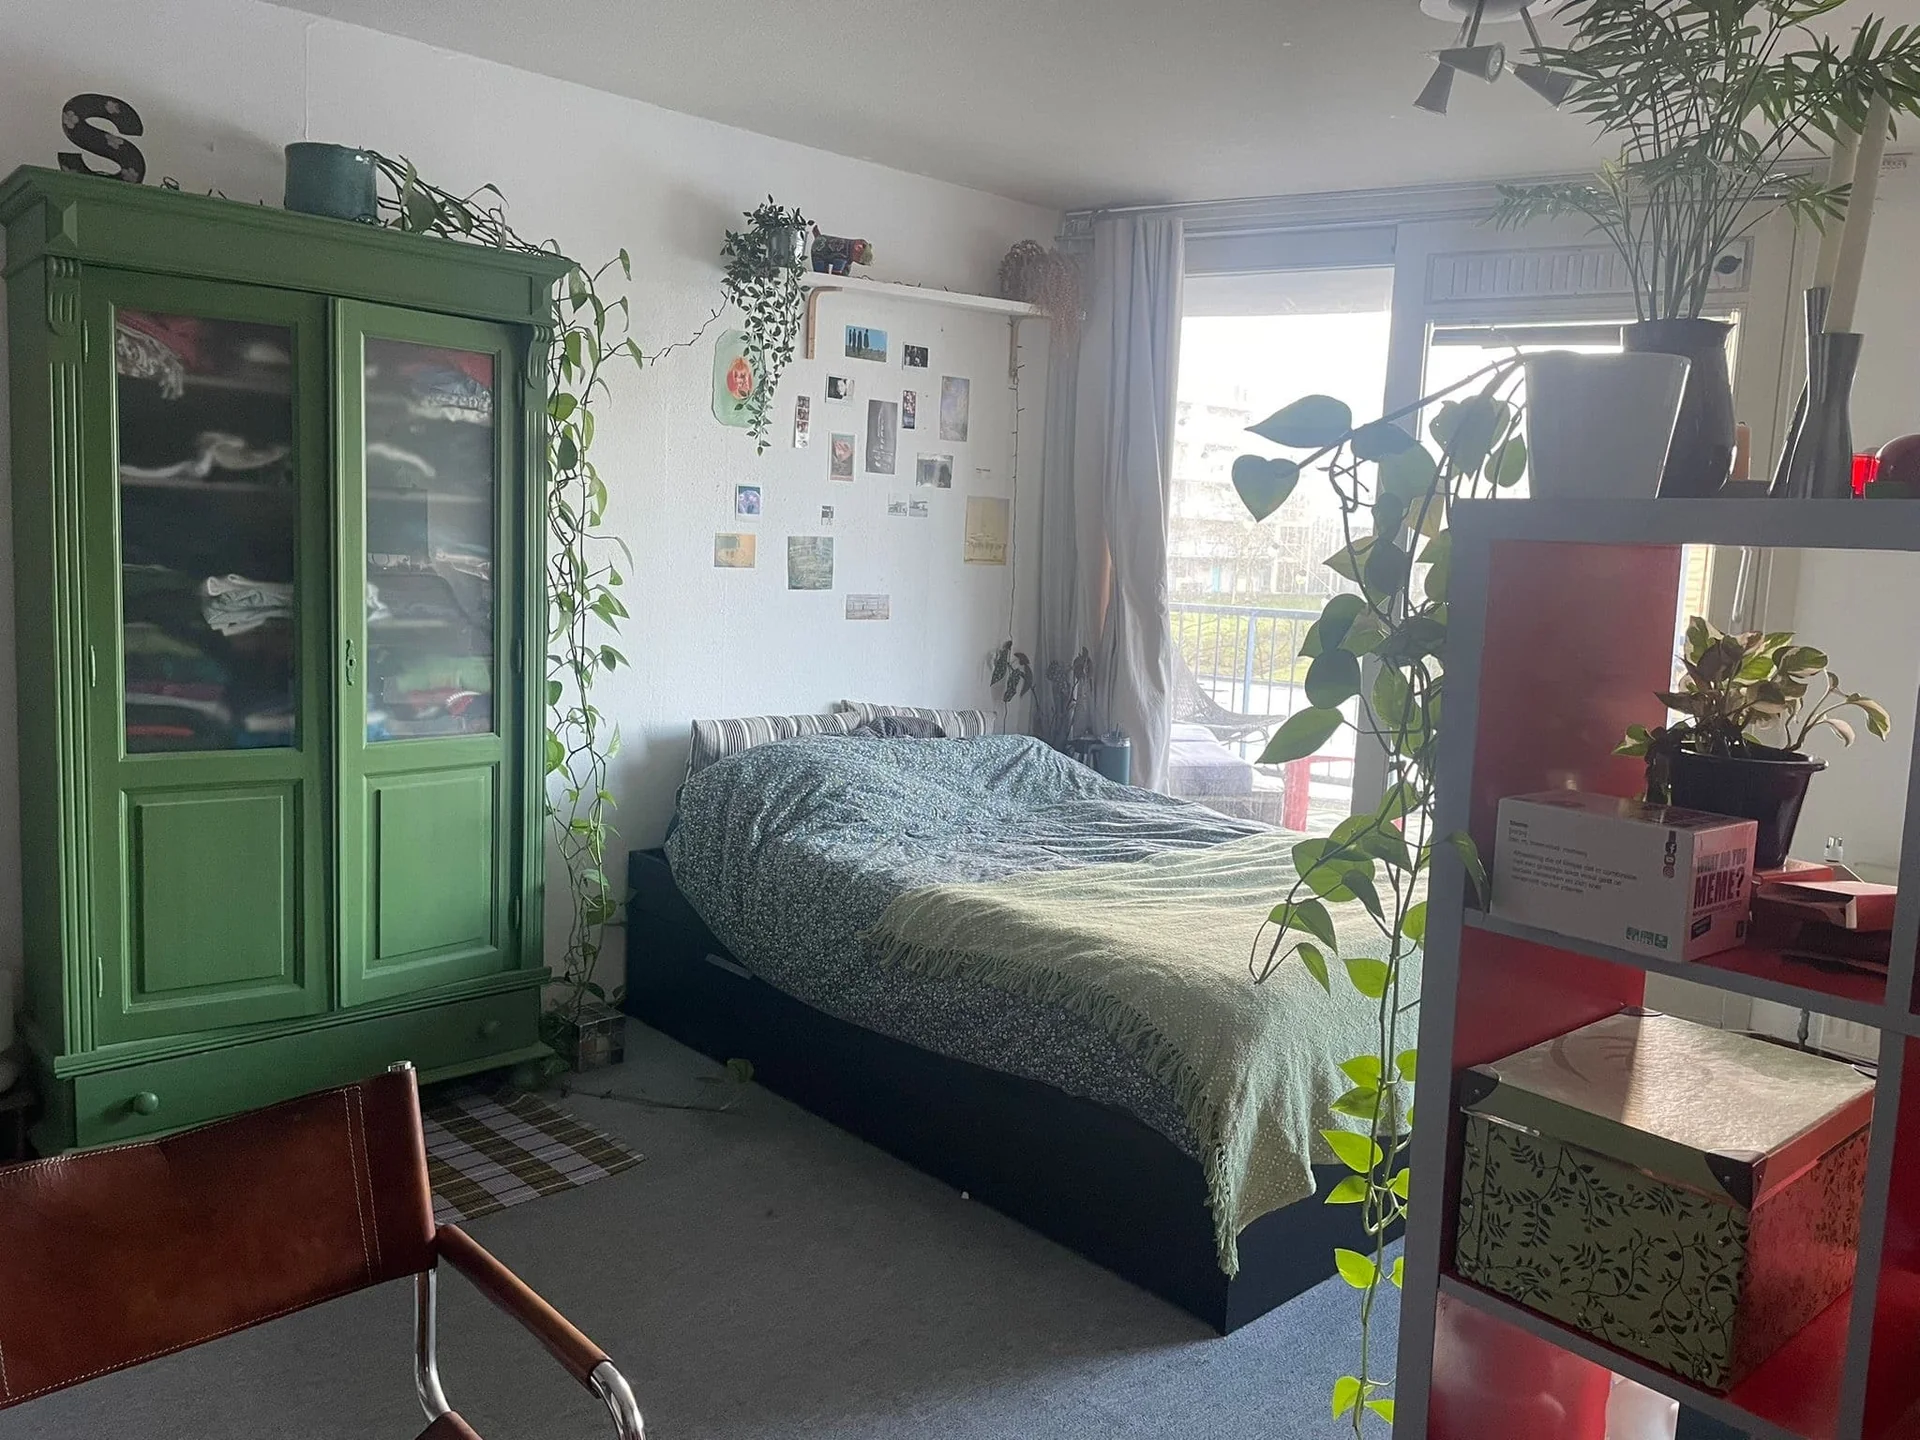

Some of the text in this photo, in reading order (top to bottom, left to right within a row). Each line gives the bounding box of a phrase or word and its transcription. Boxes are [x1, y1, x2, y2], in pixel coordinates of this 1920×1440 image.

[57, 93, 147, 184] S
[1732, 848, 1748, 867] YOU
[1693, 866, 1745, 909] MEME?
